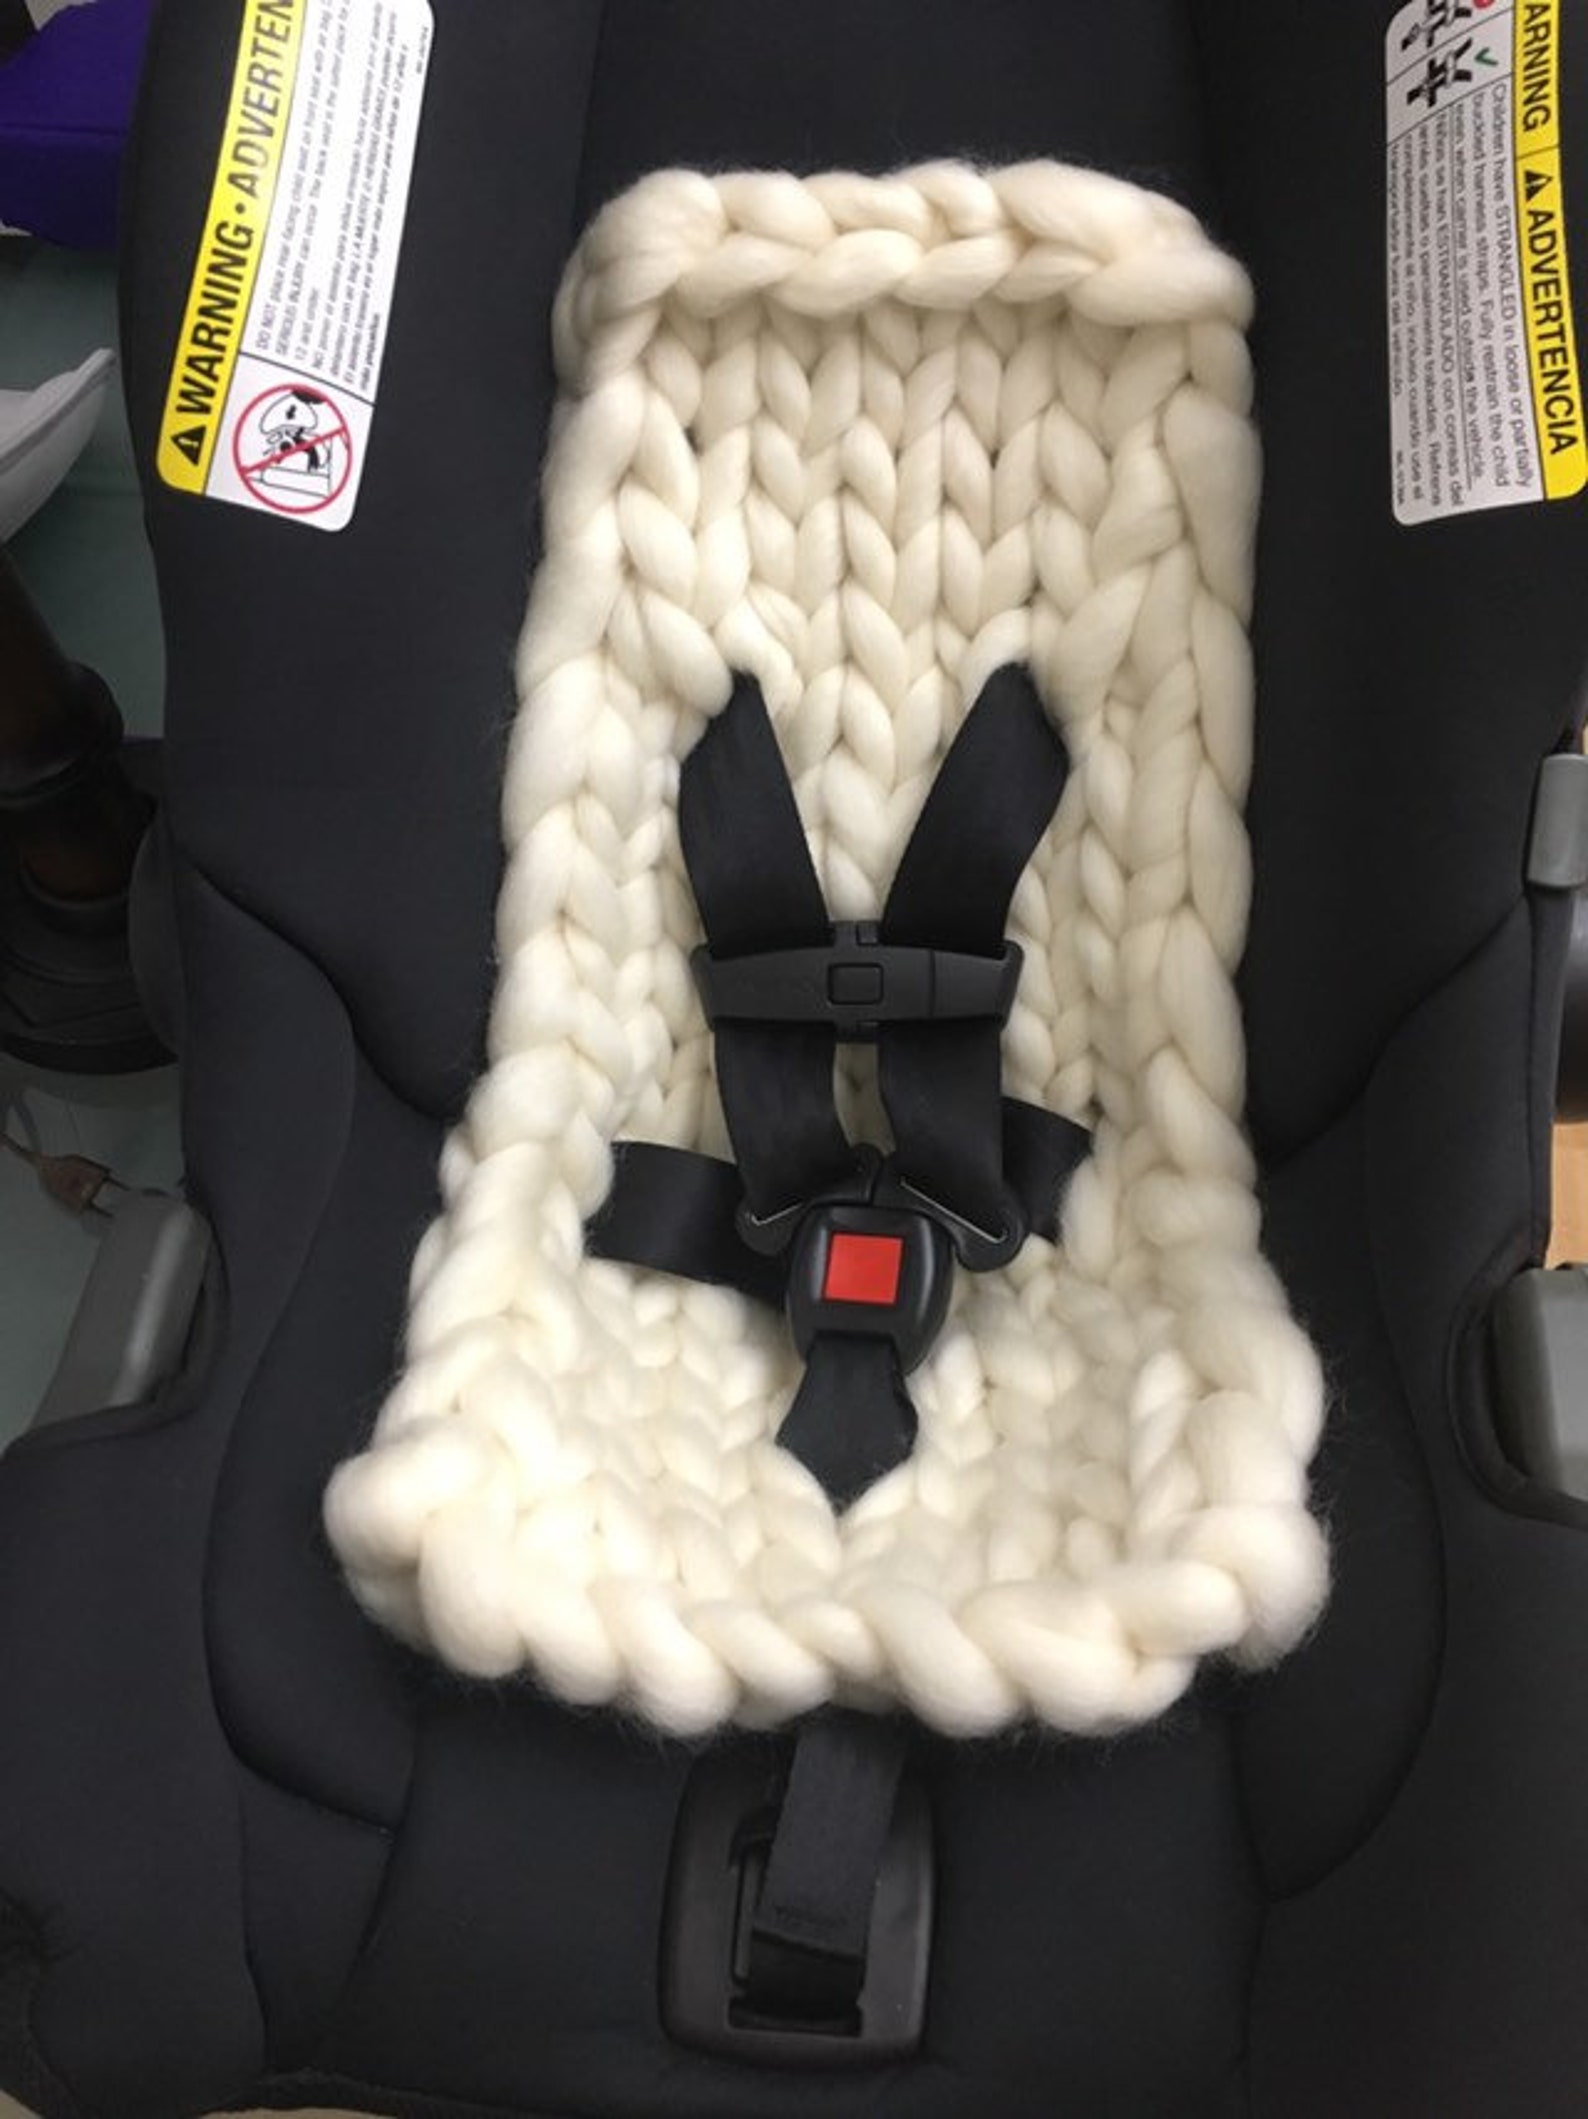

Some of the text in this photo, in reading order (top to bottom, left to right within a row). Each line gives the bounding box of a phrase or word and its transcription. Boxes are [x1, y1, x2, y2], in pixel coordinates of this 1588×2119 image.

[1490, 83, 1533, 487] Children have STRANGLED in loose or partially
[176, 219, 254, 417] WARNING
[1477, 298, 1495, 340] Fully
[1528, 209, 1578, 455] ADVERTENCIA
[1465, 385, 1478, 415] the
[1481, 344, 1499, 410] restrain
[1487, 412, 1503, 442] the
[1490, 444, 1510, 487] child
